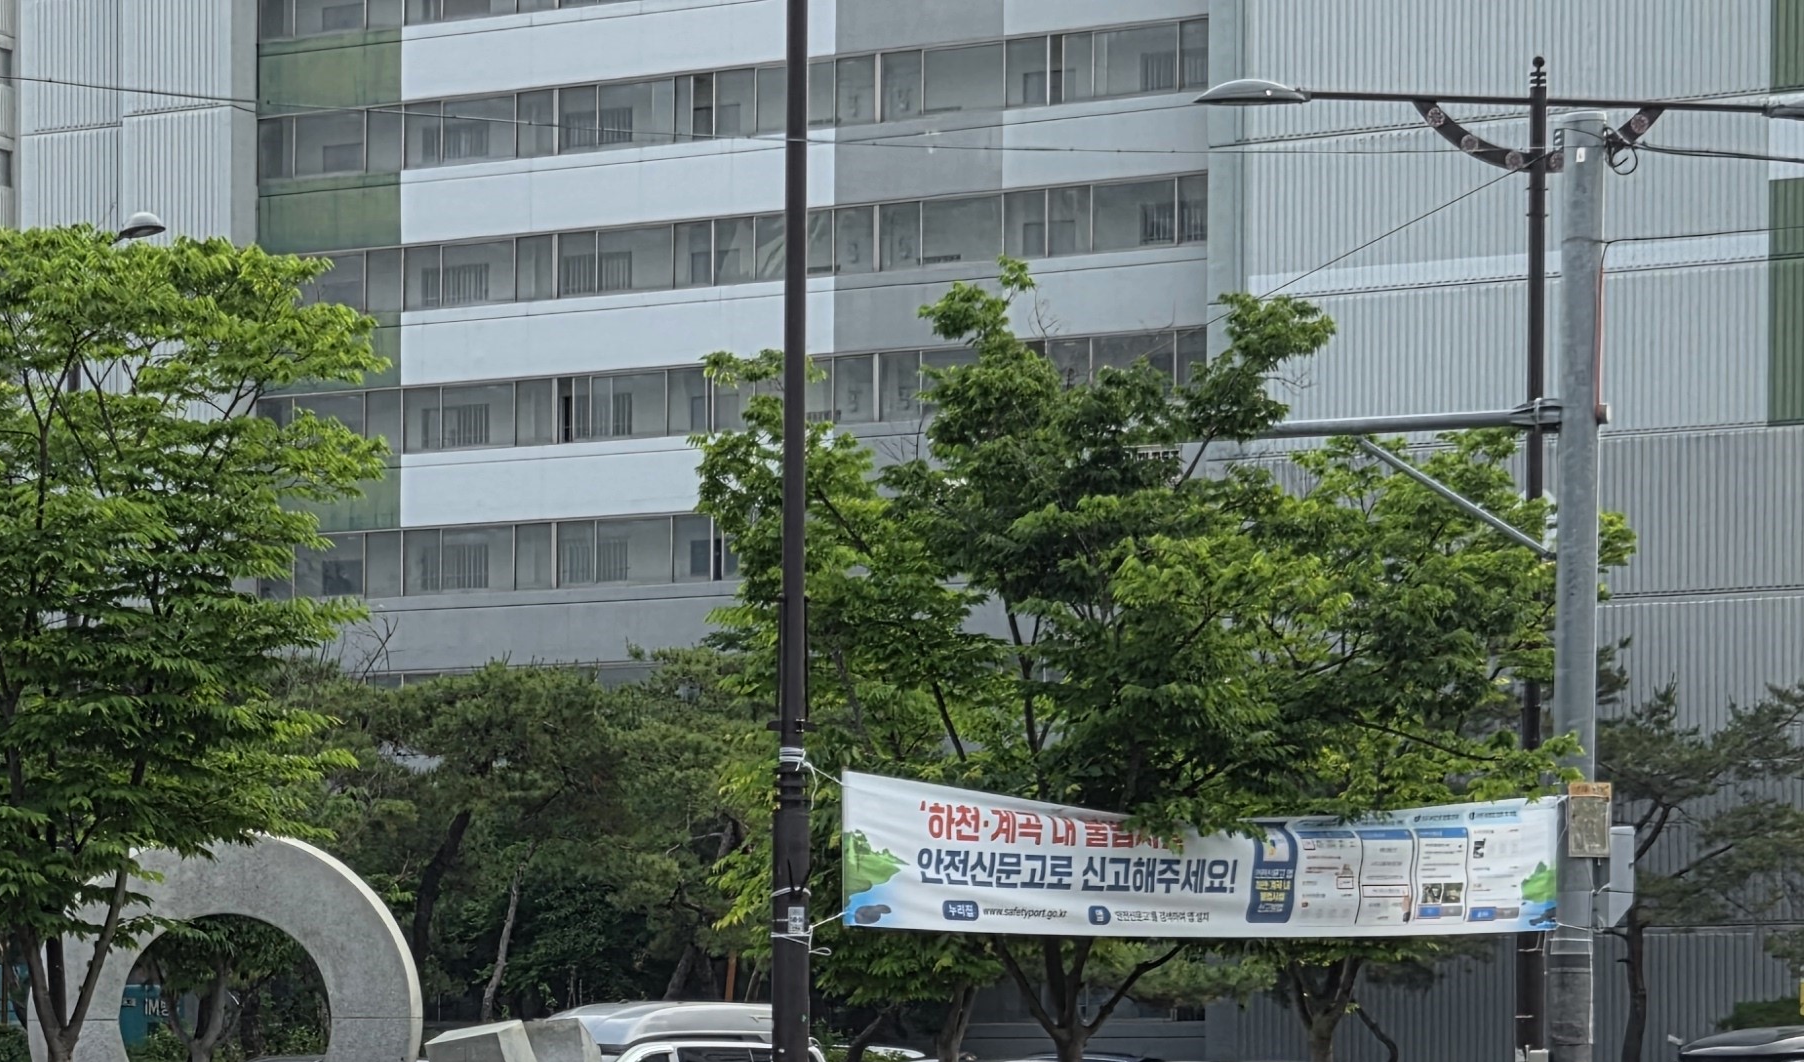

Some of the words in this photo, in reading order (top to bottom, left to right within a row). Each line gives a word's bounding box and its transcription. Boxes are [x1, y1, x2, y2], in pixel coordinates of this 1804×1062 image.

[1050, 816, 1077, 847] 내
[917, 847, 1073, 891] 안전신문고로
[1081, 856, 1238, 894] 신고해주세요!
